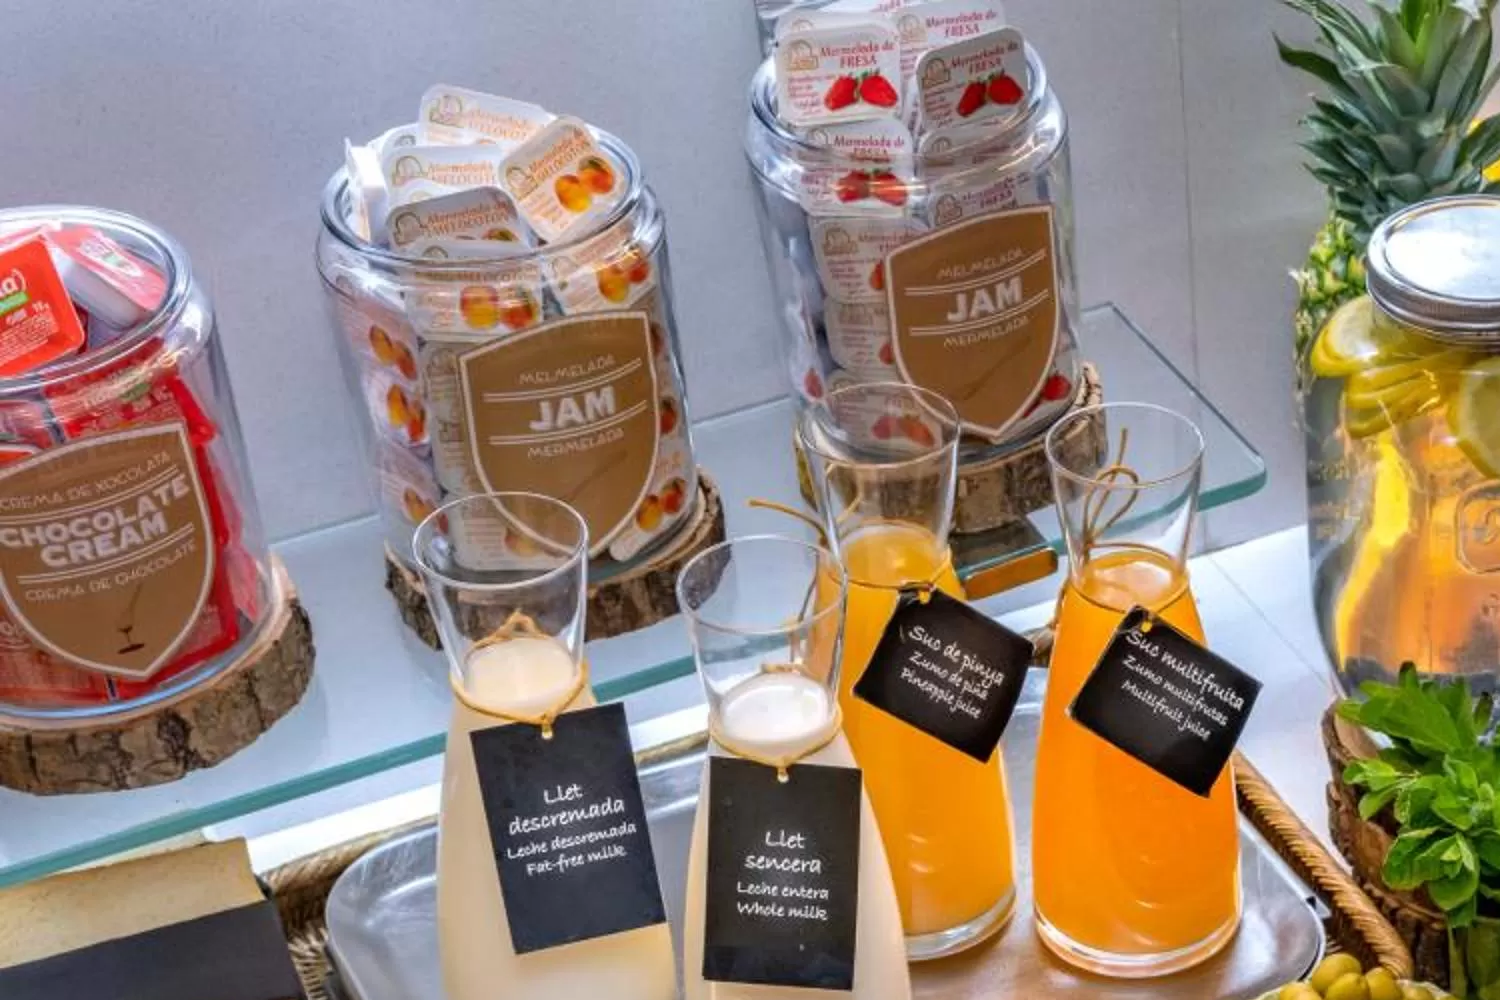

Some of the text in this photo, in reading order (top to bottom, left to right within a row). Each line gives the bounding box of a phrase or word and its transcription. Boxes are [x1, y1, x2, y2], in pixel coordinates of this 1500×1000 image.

[946, 276, 1023, 321] JAM
[518, 353, 616, 385] MELMELADA
[529, 385, 616, 431] JAM
[0, 472, 191, 547] CHOCOLATE
[40, 511, 168, 567] CREAM
[908, 650, 949, 679] Zumo
[948, 672, 963, 687] de
[943, 641, 961, 663] de
[960, 653, 1005, 690] pinya
[1161, 651, 1245, 711] multifruita
[900, 666, 981, 719] Pineapple juice
[1122, 654, 1229, 726] Zumo multifrutas
[1121, 680, 1211, 741] Multifruit juice
[543, 783, 584, 804] Llet
[508, 796, 625, 836] descremada
[506, 821, 637, 859] Leche descremada
[764, 829, 806, 849] Llet
[526, 844, 628, 877] Fat-free milk
[743, 854, 822, 875] sencera
[736, 881, 829, 900] Leche entera
[736, 901, 829, 921] Whole milk
